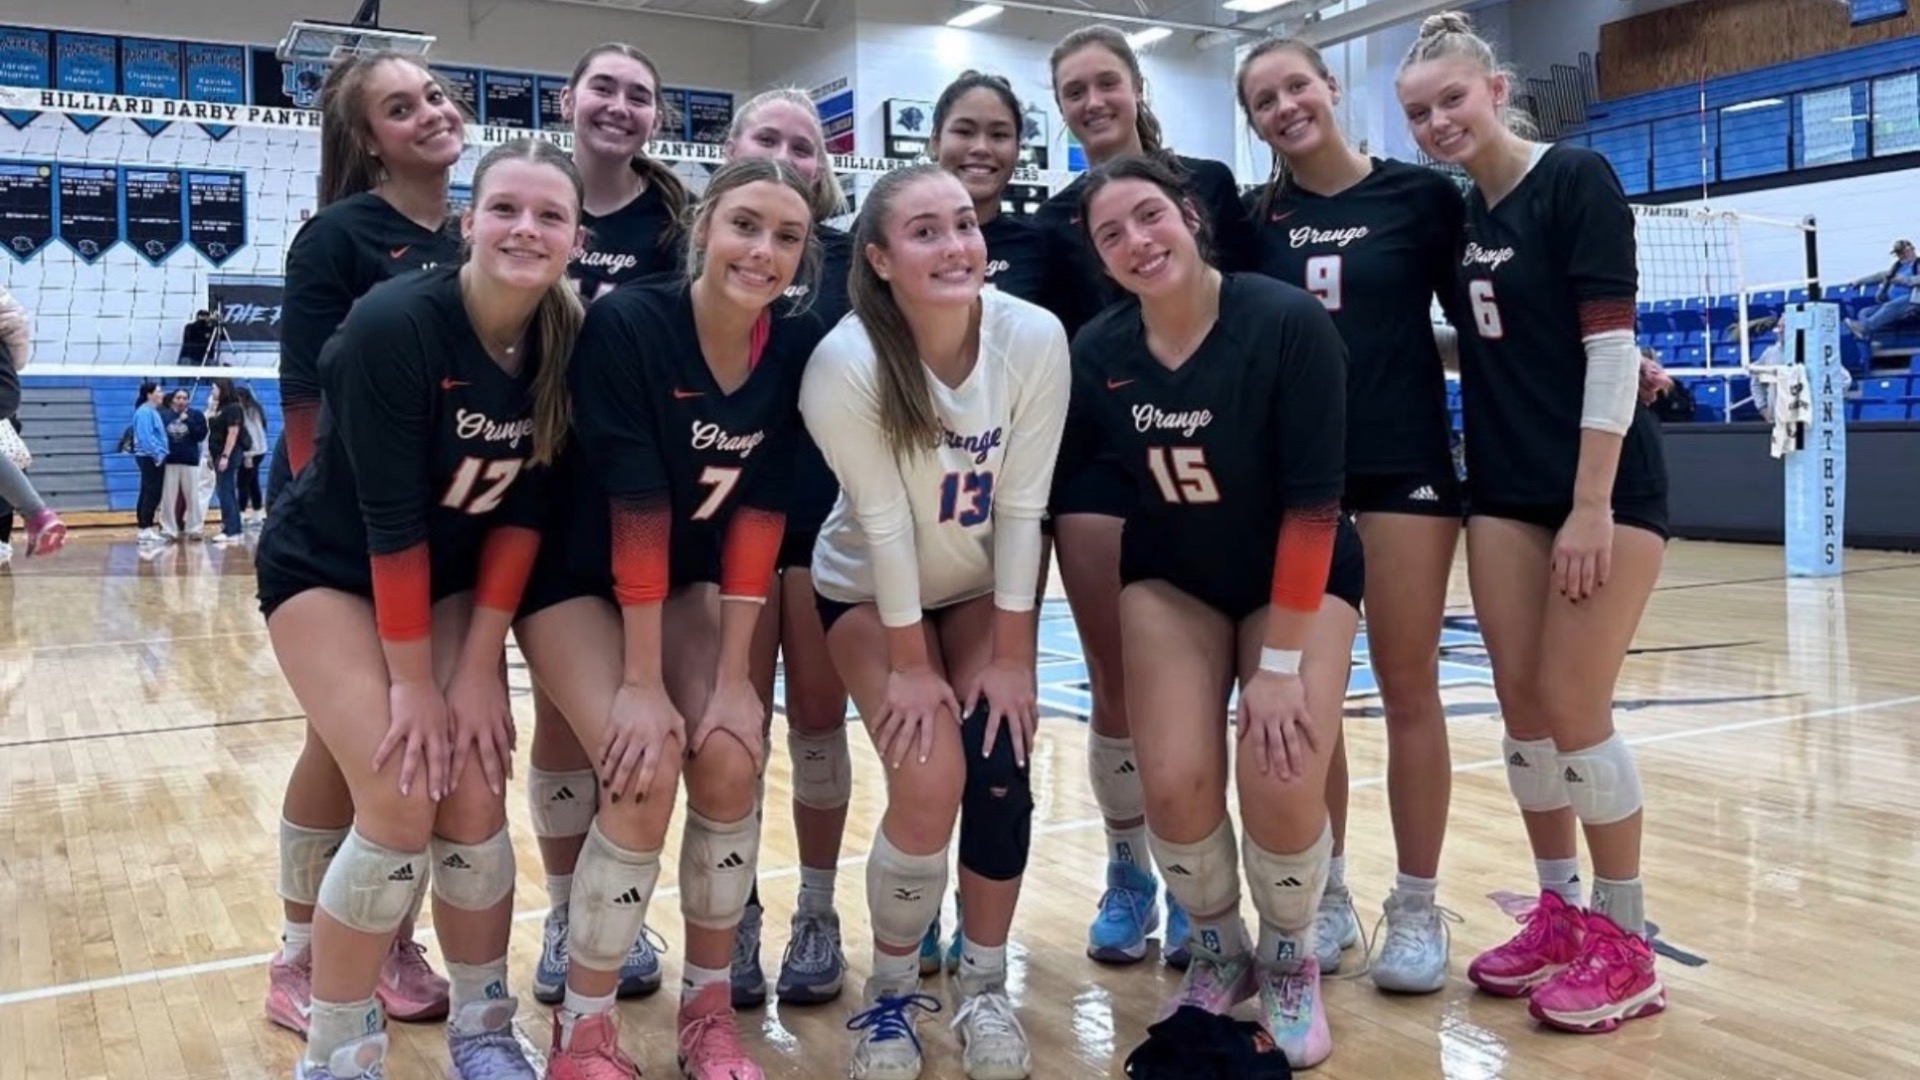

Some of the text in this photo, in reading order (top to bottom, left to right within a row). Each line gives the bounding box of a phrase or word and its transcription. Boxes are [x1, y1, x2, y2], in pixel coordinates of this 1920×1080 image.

[40, 91, 152, 114] HILLIARD
[164, 101, 236, 120] DARBY
[1289, 225, 1369, 248] Orange
[1305, 254, 1342, 311] 9
[1469, 279, 1504, 339] 6
[223, 303, 271, 325] THE
[690, 420, 764, 458] Orange
[1132, 403, 1213, 437] Orange
[1146, 446, 1222, 504] 15
[1822, 345, 1835, 565] PANTHERS
[439, 455, 524, 516] 12
[690, 465, 743, 520] 7
[938, 470, 994, 527] 13
